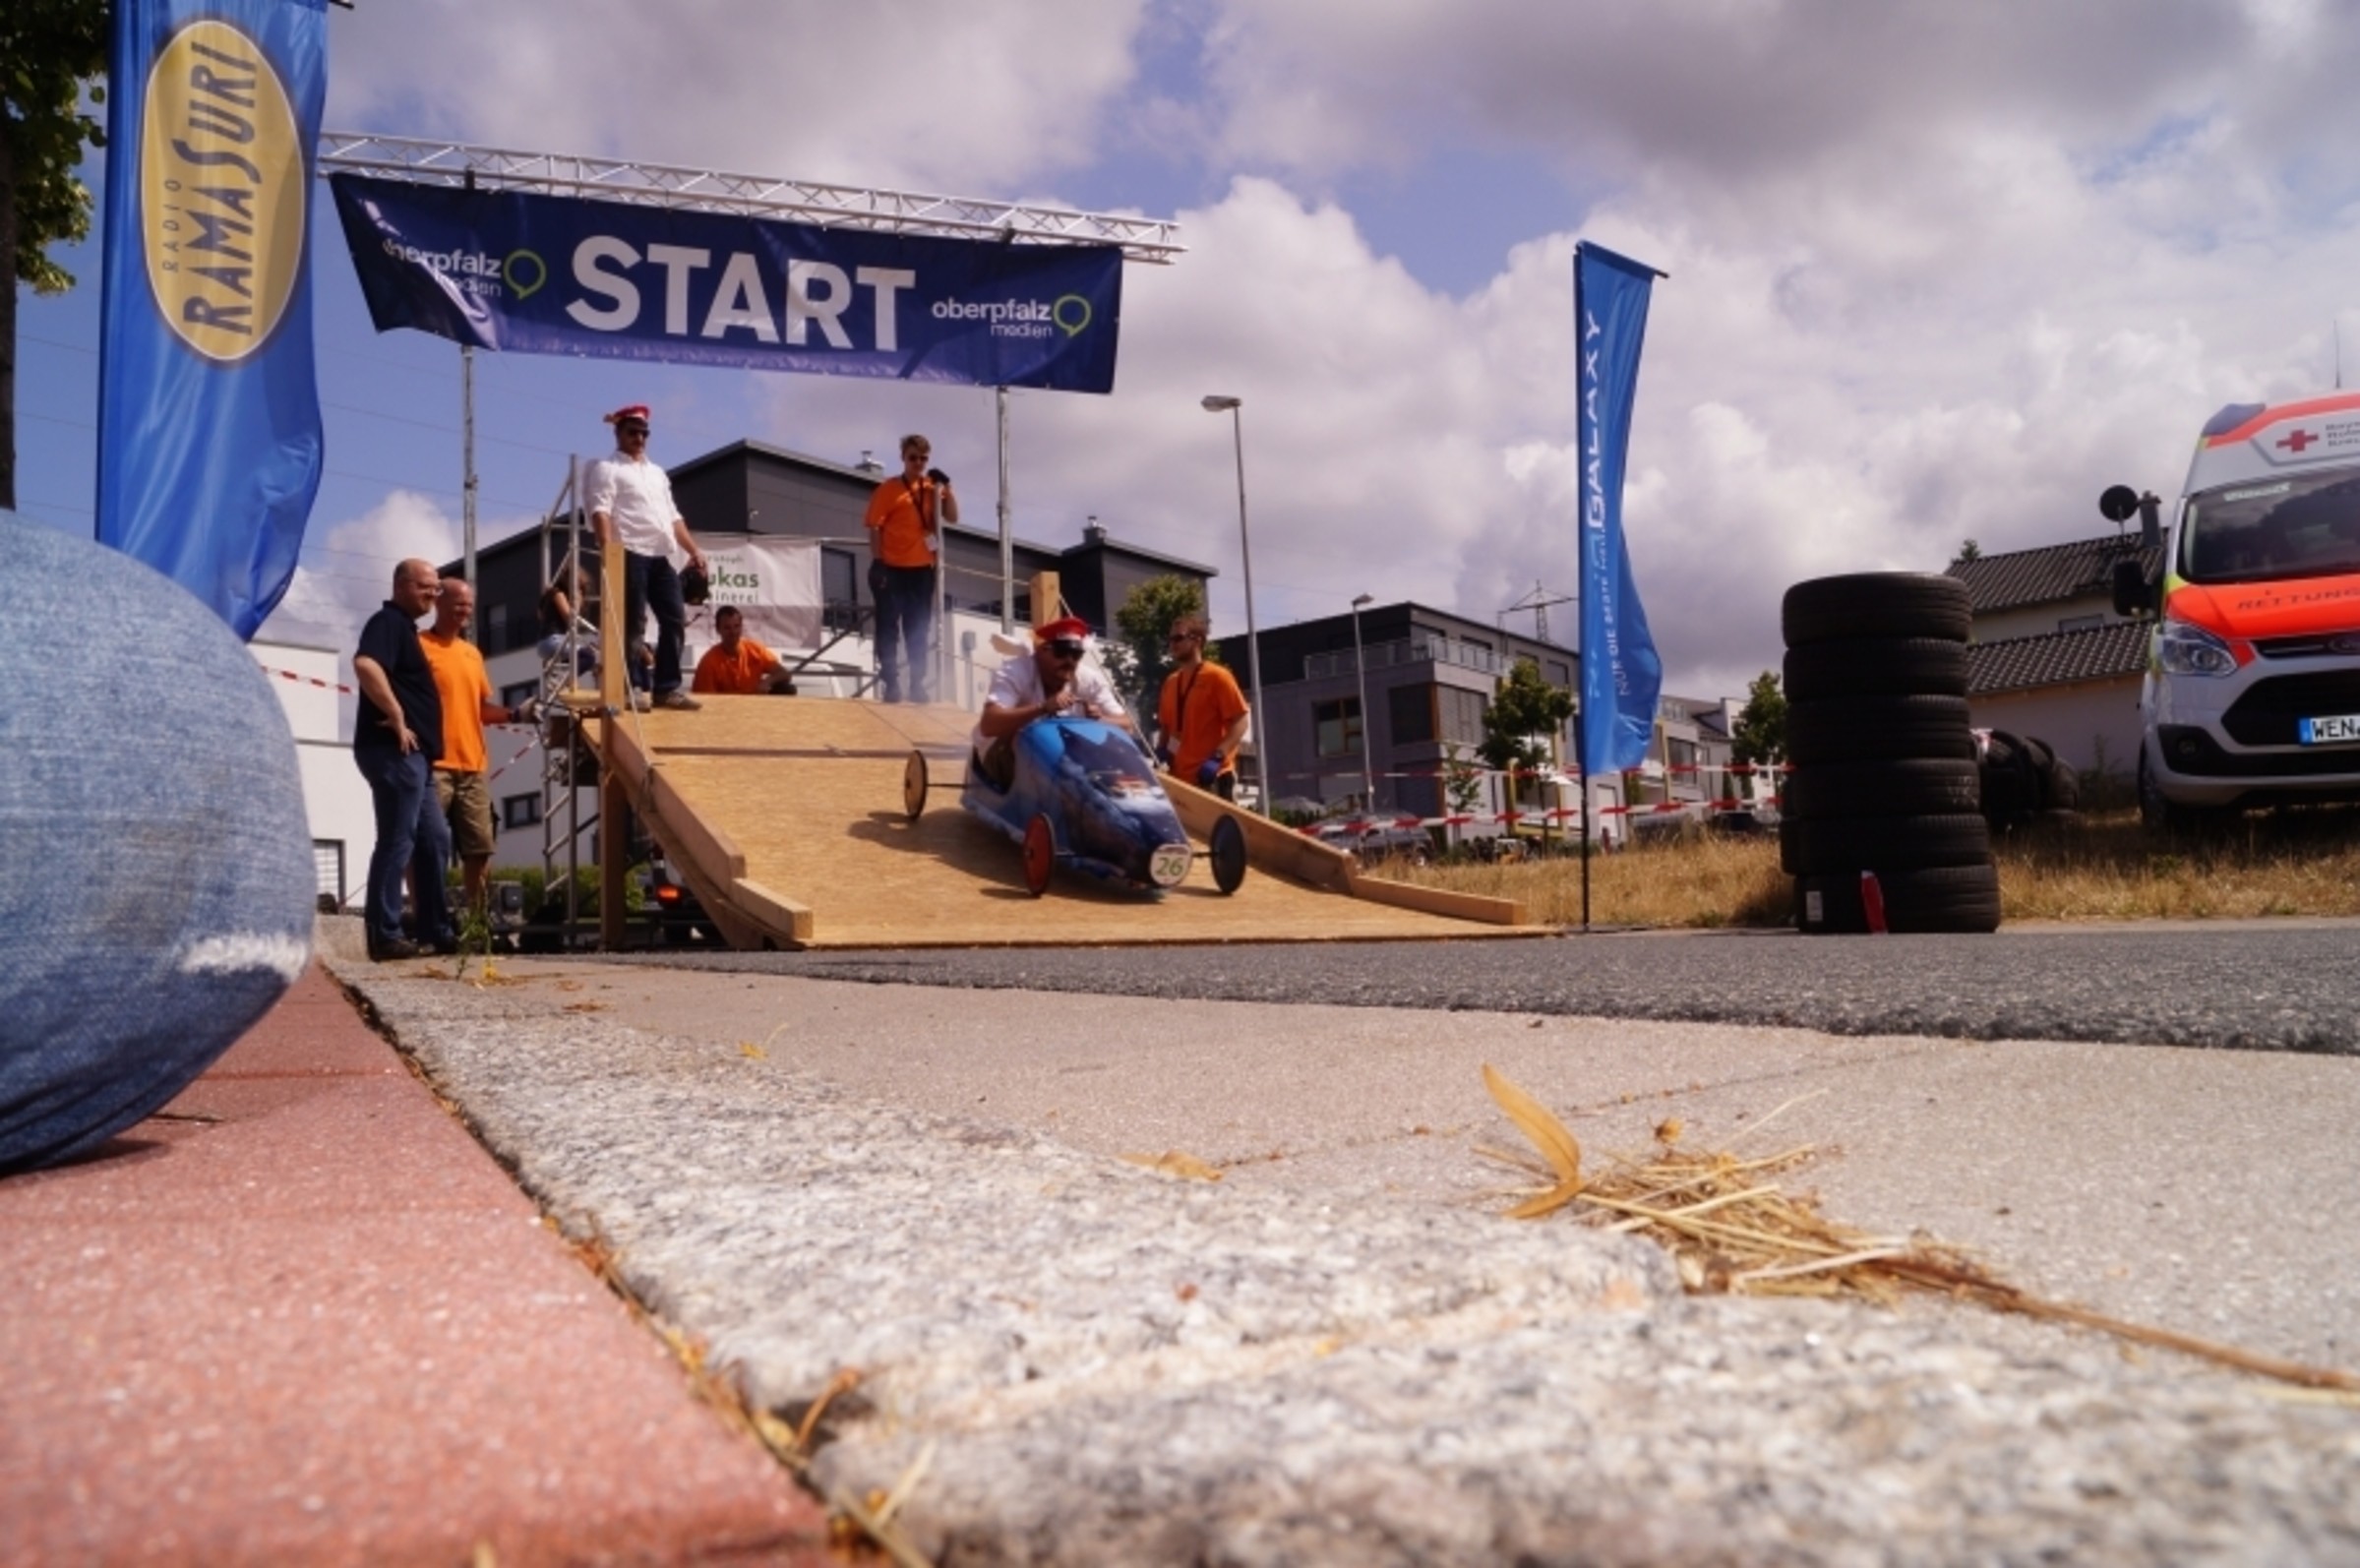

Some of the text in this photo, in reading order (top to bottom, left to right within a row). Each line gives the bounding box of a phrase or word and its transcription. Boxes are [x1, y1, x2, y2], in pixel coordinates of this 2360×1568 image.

[171, 41, 263, 335] RAMASURI
[162, 179, 182, 273] RADIO
[565, 235, 916, 352] START
[932, 298, 1053, 324] oberpfalz
[991, 322, 1053, 338] medien
[1586, 310, 1606, 528] GALAXY
[708, 566, 758, 588] ukas
[1155, 857, 1183, 876] 26
